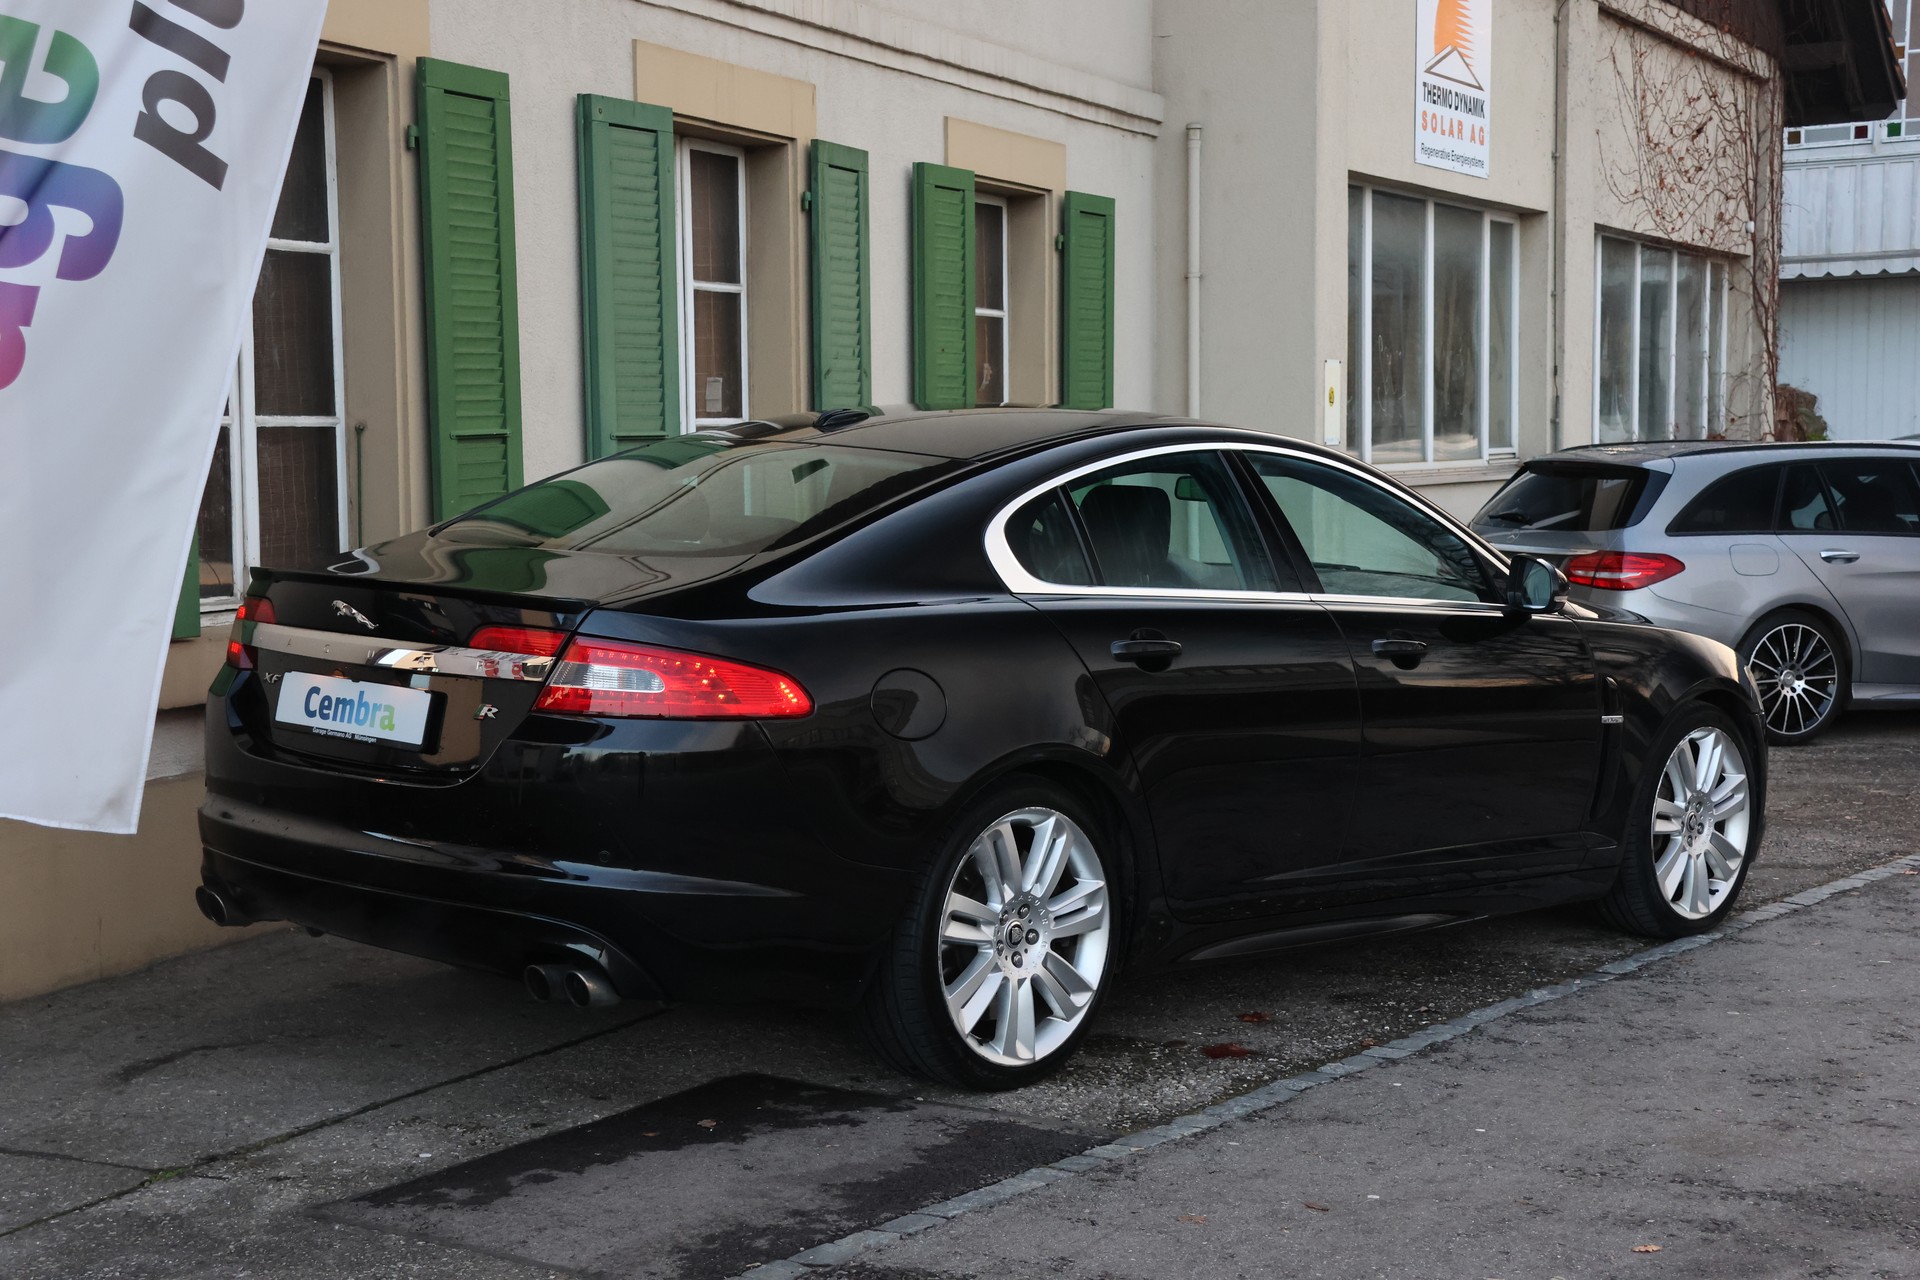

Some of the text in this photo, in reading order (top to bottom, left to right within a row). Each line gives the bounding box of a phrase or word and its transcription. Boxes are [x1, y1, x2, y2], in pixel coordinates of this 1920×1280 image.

[1422, 81, 1486, 119] THERMO DYNAMIK
[1422, 110, 1485, 146] SOLAR AG
[1421, 142, 1485, 169] Regenerative Energiesysteme
[263, 672, 282, 684] XF
[304, 686, 395, 731] Cembra
[475, 703, 499, 720] R
[313, 727, 327, 735] Garage
